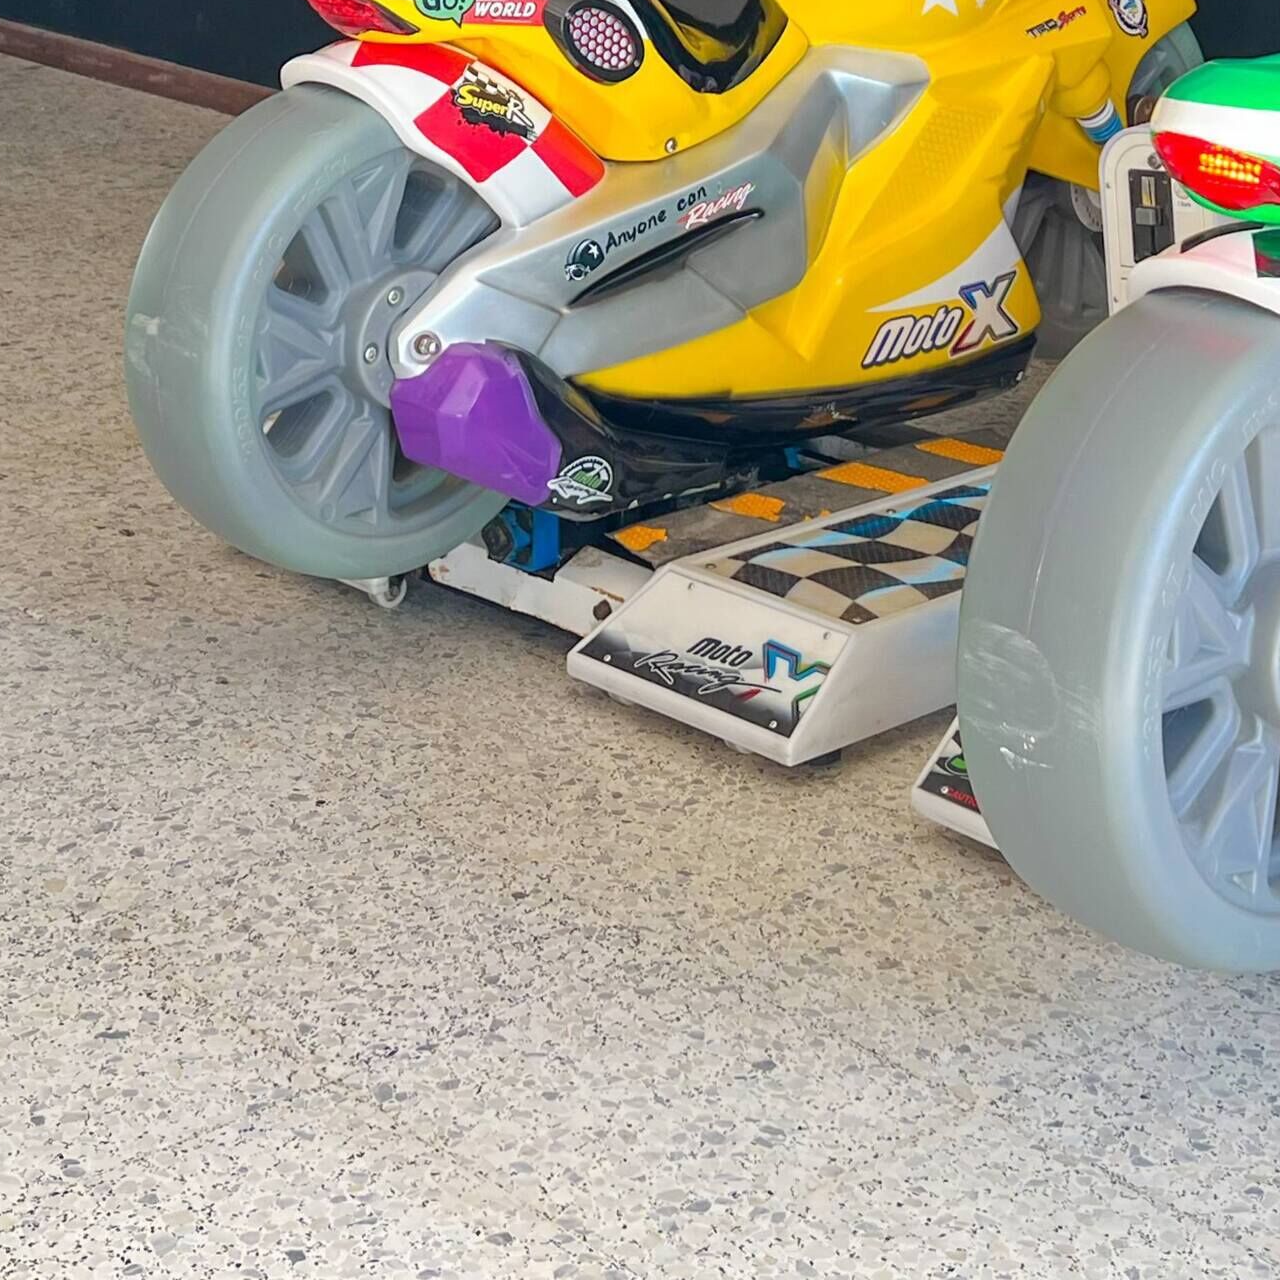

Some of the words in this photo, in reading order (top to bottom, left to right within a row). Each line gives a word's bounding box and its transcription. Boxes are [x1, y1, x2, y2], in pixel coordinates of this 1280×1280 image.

[473, 1, 538, 19] WORLD
[605, 209, 668, 255] Anyone
[677, 185, 708, 213] can
[682, 181, 757, 230] Racing
[634, 649, 782, 695] Racing
